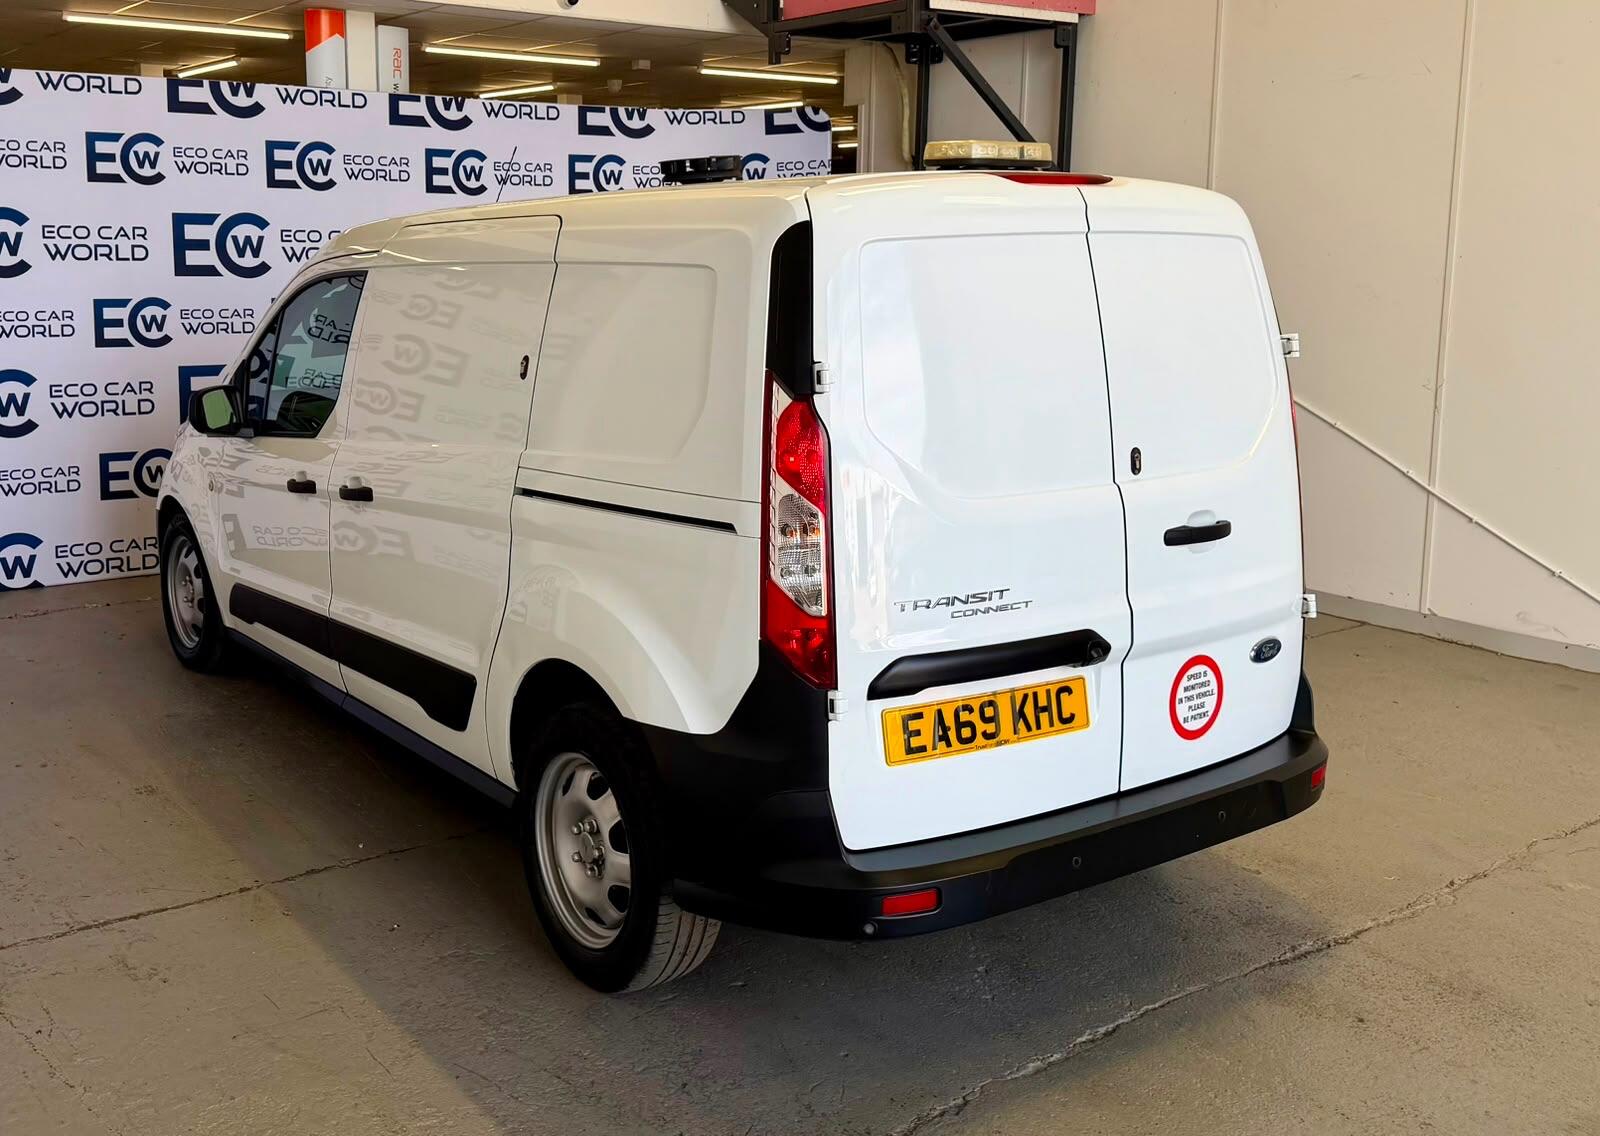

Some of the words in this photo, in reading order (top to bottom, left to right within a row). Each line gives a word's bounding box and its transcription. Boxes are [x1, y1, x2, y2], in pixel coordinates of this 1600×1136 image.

[35, 72, 142, 95] WORLD
[276, 87, 367, 108] WORLD
[482, 102, 561, 120] WORLD
[664, 111, 745, 125] WORLD
[26, 141, 65, 153] CAR
[173, 147, 207, 158] ECO
[212, 149, 248, 160] CAR
[344, 155, 374, 165] ECO
[378, 156, 409, 167] CAR
[494, 161, 521, 172] ECO
[525, 163, 552, 172] CAR
[777, 161, 804, 171] ECO
[174, 161, 249, 176] WORLD
[344, 168, 410, 182] WORLD
[633, 164, 661, 174] ECO
[495, 173, 553, 187] WORLD
[42, 225, 90, 239] ECO
[98, 226, 147, 240] CAR
[281, 230, 322, 243] ECO
[43, 244, 148, 261] WORLD
[0, 311, 29, 322] CO
[35, 311, 73, 321] CAR
[180, 309, 214, 319] ECO
[219, 309, 254, 319] CAR
[0, 324, 75, 338] WORLD
[181, 322, 255, 336] WORLD
[49, 383, 97, 398] ECO
[104, 381, 154, 396] CAR
[0, 369, 39, 438] CW
[51, 398, 155, 419] WORLD
[0, 469, 35, 481] ECO
[41, 466, 80, 478] CAR
[0, 478, 81, 496] WORLD
[55, 541, 103, 558] ECO
[109, 537, 158, 552] CAR
[0, 533, 45, 592] CW
[56, 554, 160, 578] WORLD
[894, 588, 1011, 613] TRANSIT
[951, 601, 1032, 618] CONNECT
[1187, 671, 1202, 681] SPEED
[1183, 680, 1211, 693] MONITORED
[1184, 694, 1195, 703] THIS
[1188, 701, 1206, 712] PLEASE
[902, 700, 1000, 756] EA69
[1010, 686, 1076, 736] KHC
[1183, 716, 1189, 724] BE
